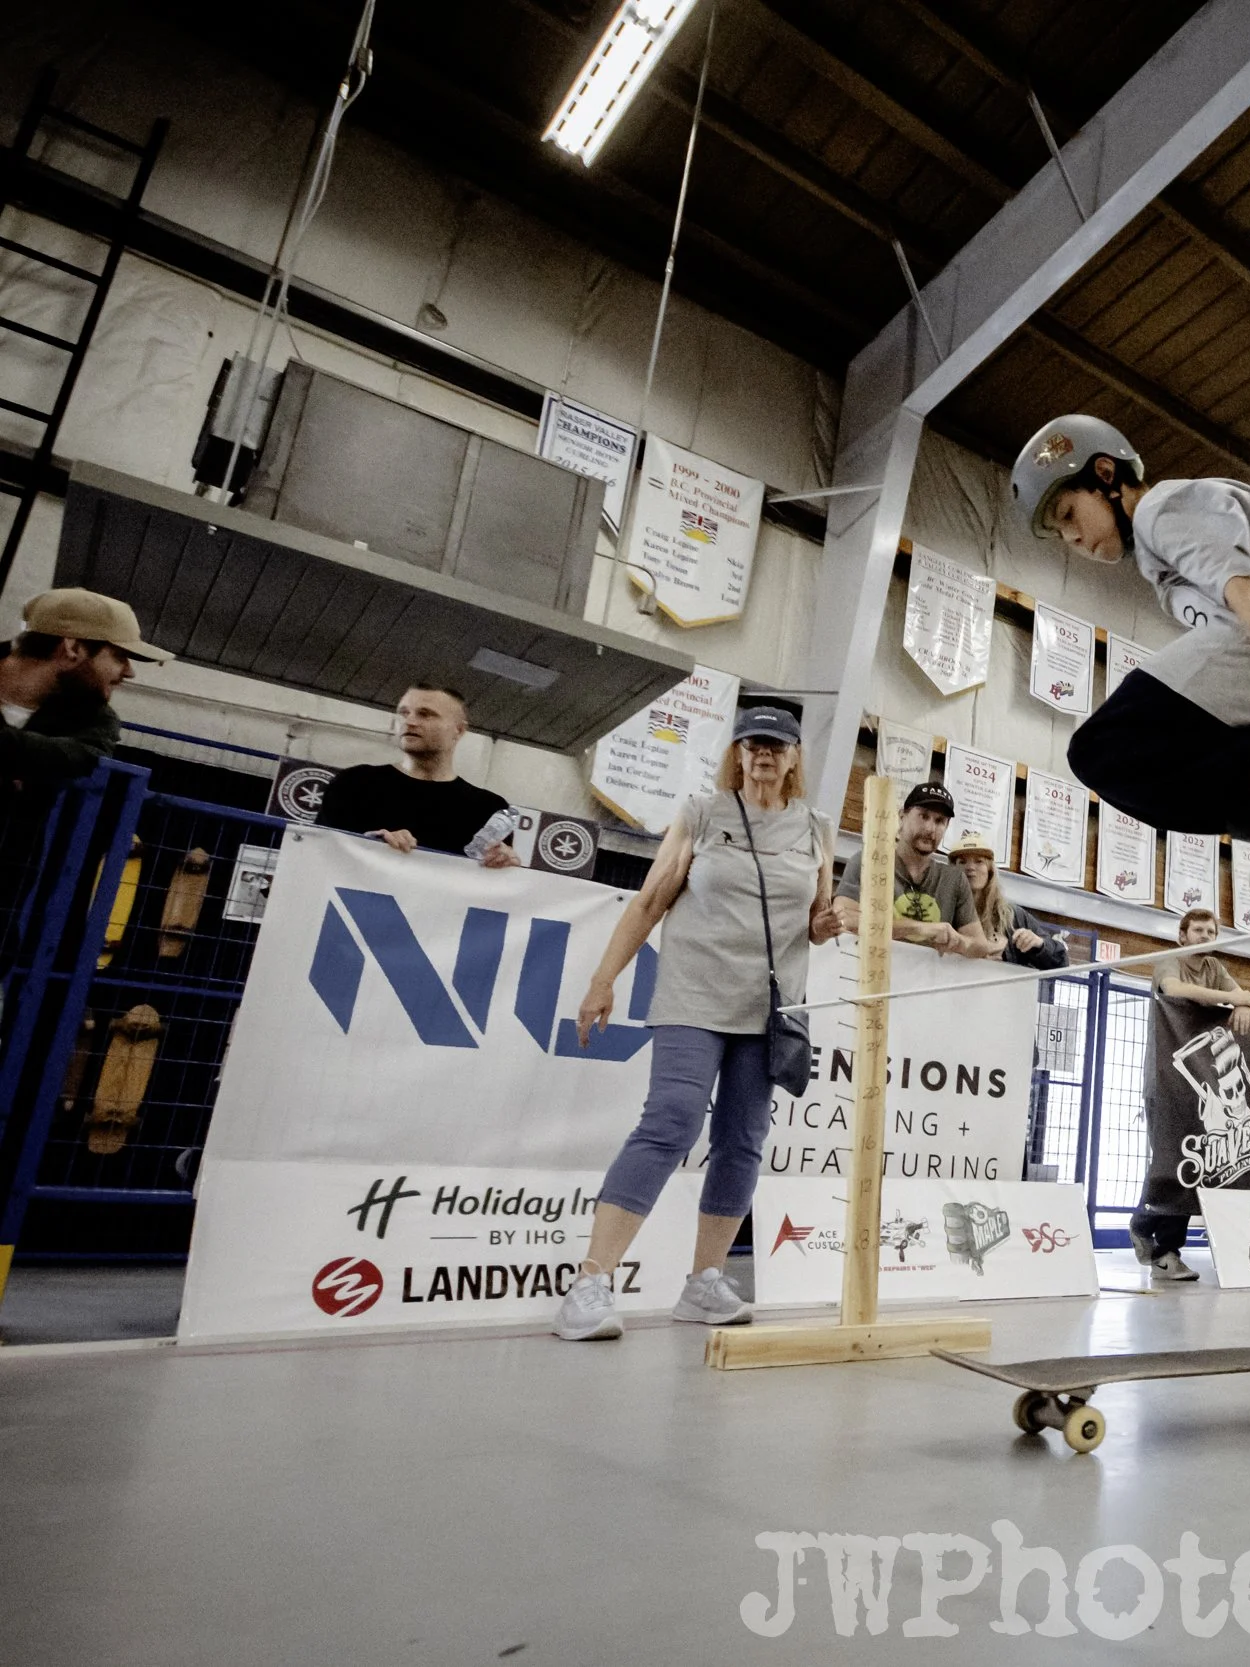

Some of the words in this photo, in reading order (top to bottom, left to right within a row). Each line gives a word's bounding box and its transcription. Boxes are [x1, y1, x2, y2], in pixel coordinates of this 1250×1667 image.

[557, 419, 626, 453] CHAMPIONS
[594, 424, 628, 443] VALLEY
[673, 463, 699, 479] 1999
[715, 480, 740, 498] 2000
[693, 486, 738, 512] Provincial
[669, 489, 698, 507] Mixed
[701, 502, 750, 529] Champions
[1055, 625, 1079, 643] 025
[671, 688, 713, 706] rovincial
[673, 700, 725, 721] Champions
[965, 763, 996, 784] 2024
[1045, 787, 1071, 804] 2024
[1116, 813, 1140, 830] 2023
[1182, 833, 1205, 848] 2022
[1100, 942, 1117, 960] EXIT
[866, 1018, 884, 1031] 26
[432, 1185, 565, 1223] Holiday
[490, 1229, 519, 1246] BY
[525, 1229, 566, 1245] IHG
[818, 1231, 838, 1240] ACE
[402, 1260, 642, 1304] LANDYACZ
